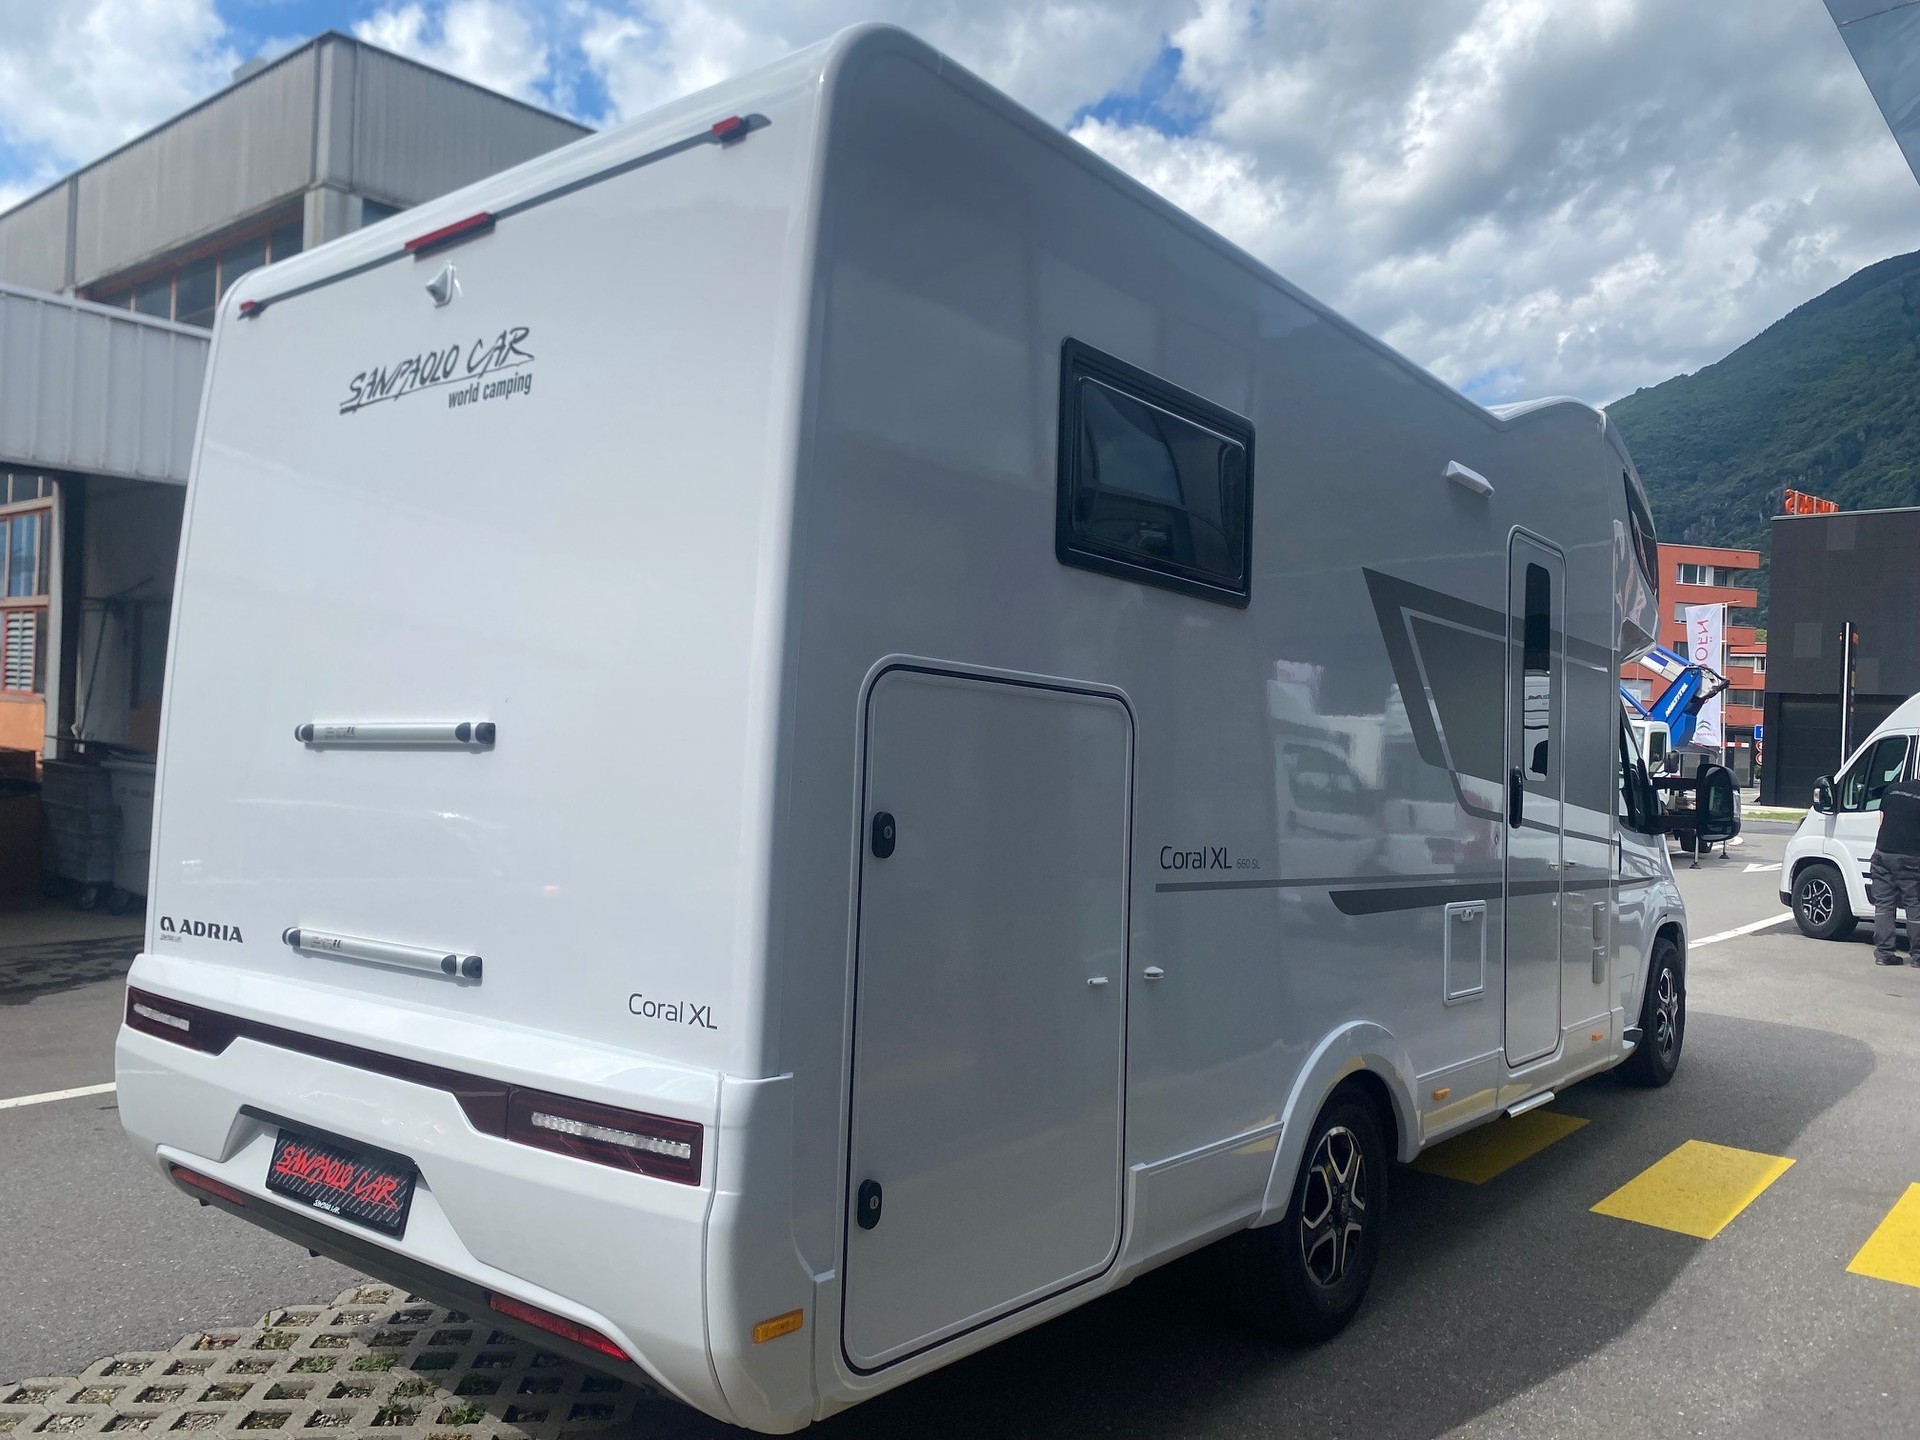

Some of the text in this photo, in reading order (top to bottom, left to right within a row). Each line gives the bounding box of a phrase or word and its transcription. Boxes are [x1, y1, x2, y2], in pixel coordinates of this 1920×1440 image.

[340, 327, 534, 411] SANPAOLO CAR
[448, 373, 532, 408] world camping
[1160, 846, 1206, 870] Coral
[1210, 847, 1232, 869] XL
[179, 919, 243, 943] ADRIA
[628, 993, 717, 1030] Coral XL
[276, 1144, 398, 1208] SANPAOLO CAR
